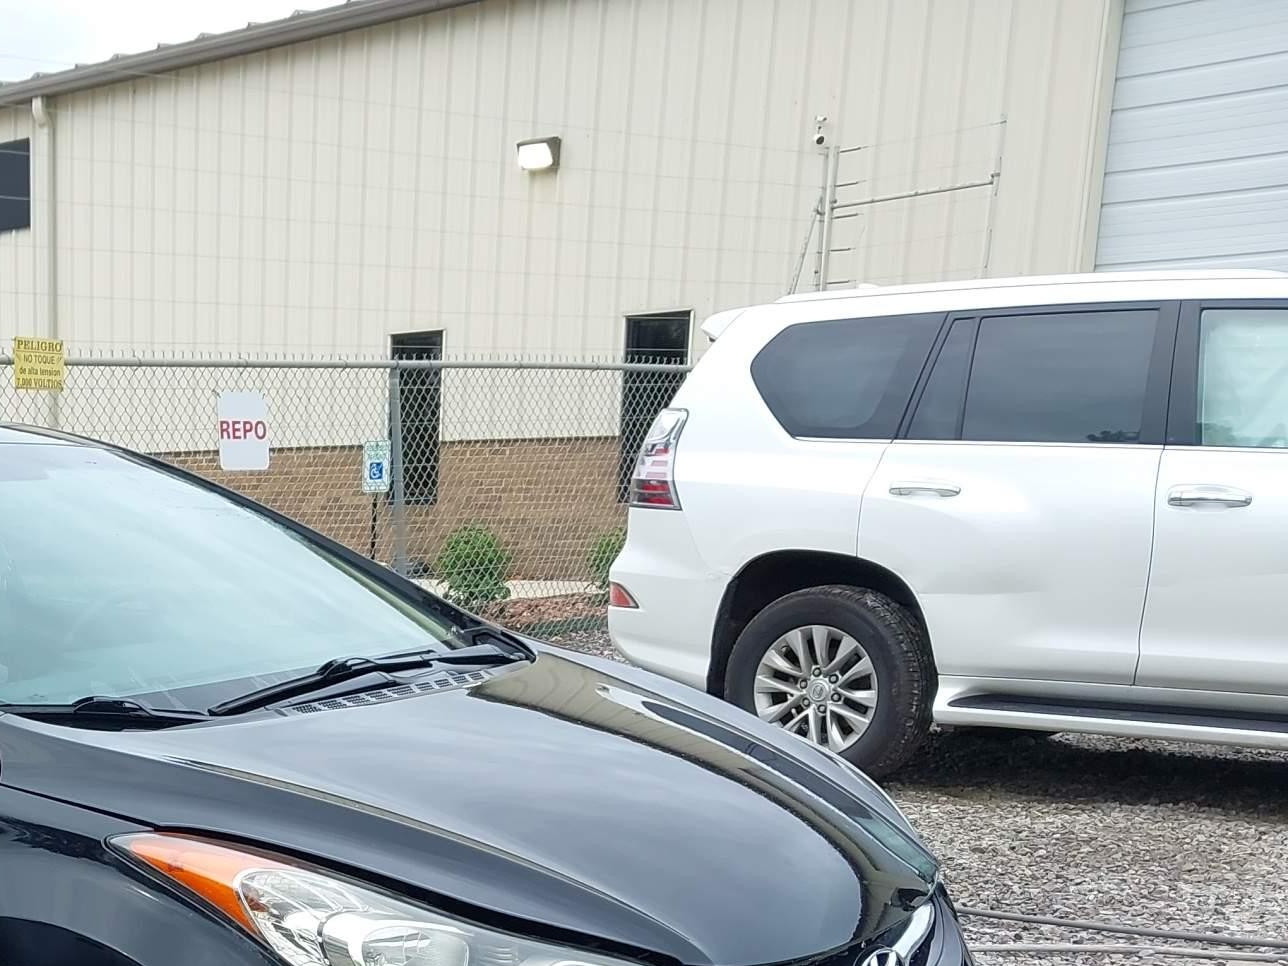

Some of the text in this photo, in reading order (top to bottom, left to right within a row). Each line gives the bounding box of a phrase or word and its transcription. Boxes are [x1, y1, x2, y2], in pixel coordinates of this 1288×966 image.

[17, 340, 62, 353] PELIGRO
[23, 354, 56, 365] NO TOQUE
[219, 420, 267, 440] REPO
